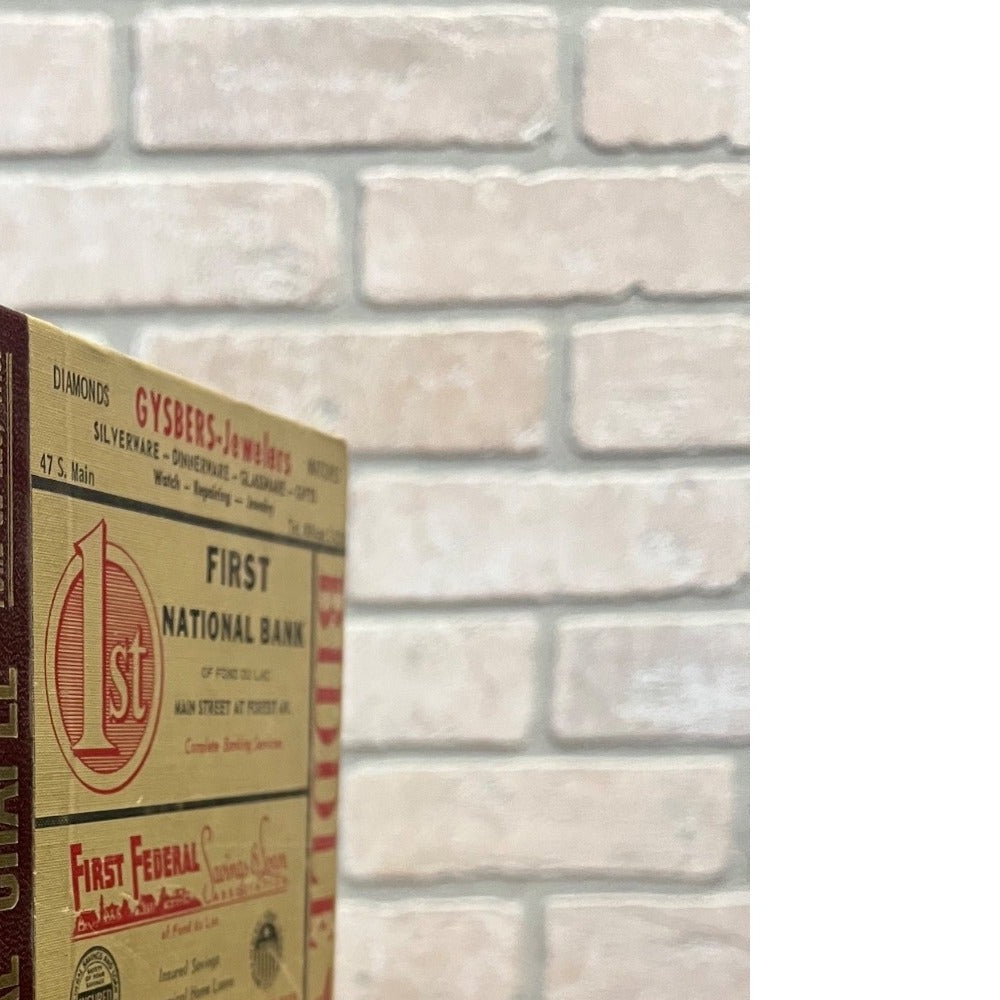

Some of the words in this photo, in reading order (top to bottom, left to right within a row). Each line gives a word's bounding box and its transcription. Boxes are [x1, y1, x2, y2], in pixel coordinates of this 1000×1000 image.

[53, 364, 110, 408] DIAMONDS
[94, 420, 160, 460] SILVERWARE
[41, 453, 53, 476] 47
[57, 460, 67, 479] S.
[71, 462, 95, 487] Main
[205, 546, 271, 593] FIRST
[162, 604, 254, 644] NATIONAL
[260, 616, 304, 648] BANK
[70, 843, 124, 912] FIRST
[130, 835, 201, 901] FEDERAL
